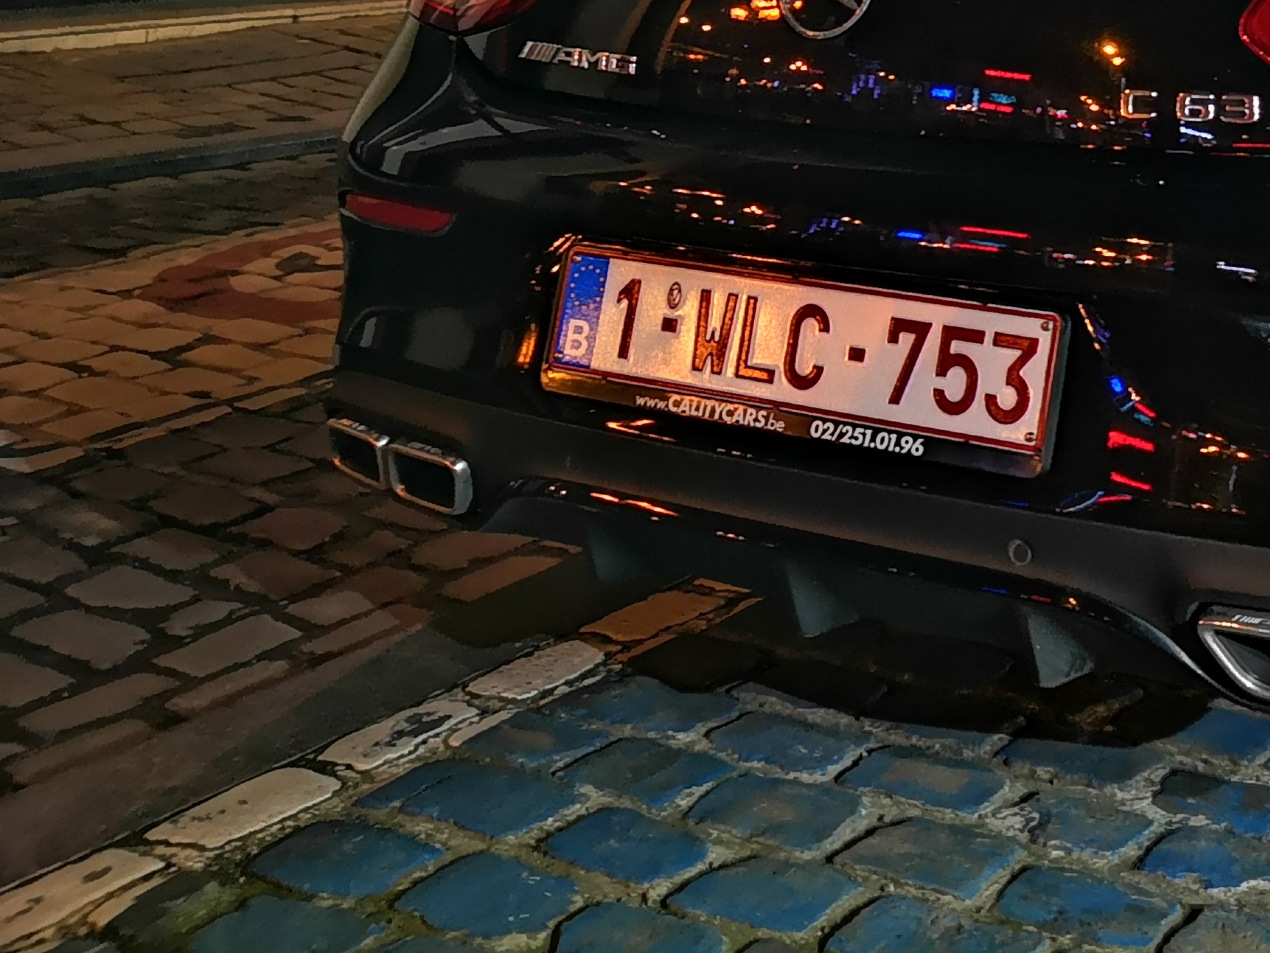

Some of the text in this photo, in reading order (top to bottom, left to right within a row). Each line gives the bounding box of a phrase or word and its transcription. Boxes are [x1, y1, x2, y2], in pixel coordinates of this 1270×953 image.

[552, 47, 637, 75] AMG
[1176, 93, 1260, 123] 63
[564, 319, 590, 356] B
[616, 278, 1040, 425] 1-WLC-753
[810, 419, 924, 457] 02/251.01.96
